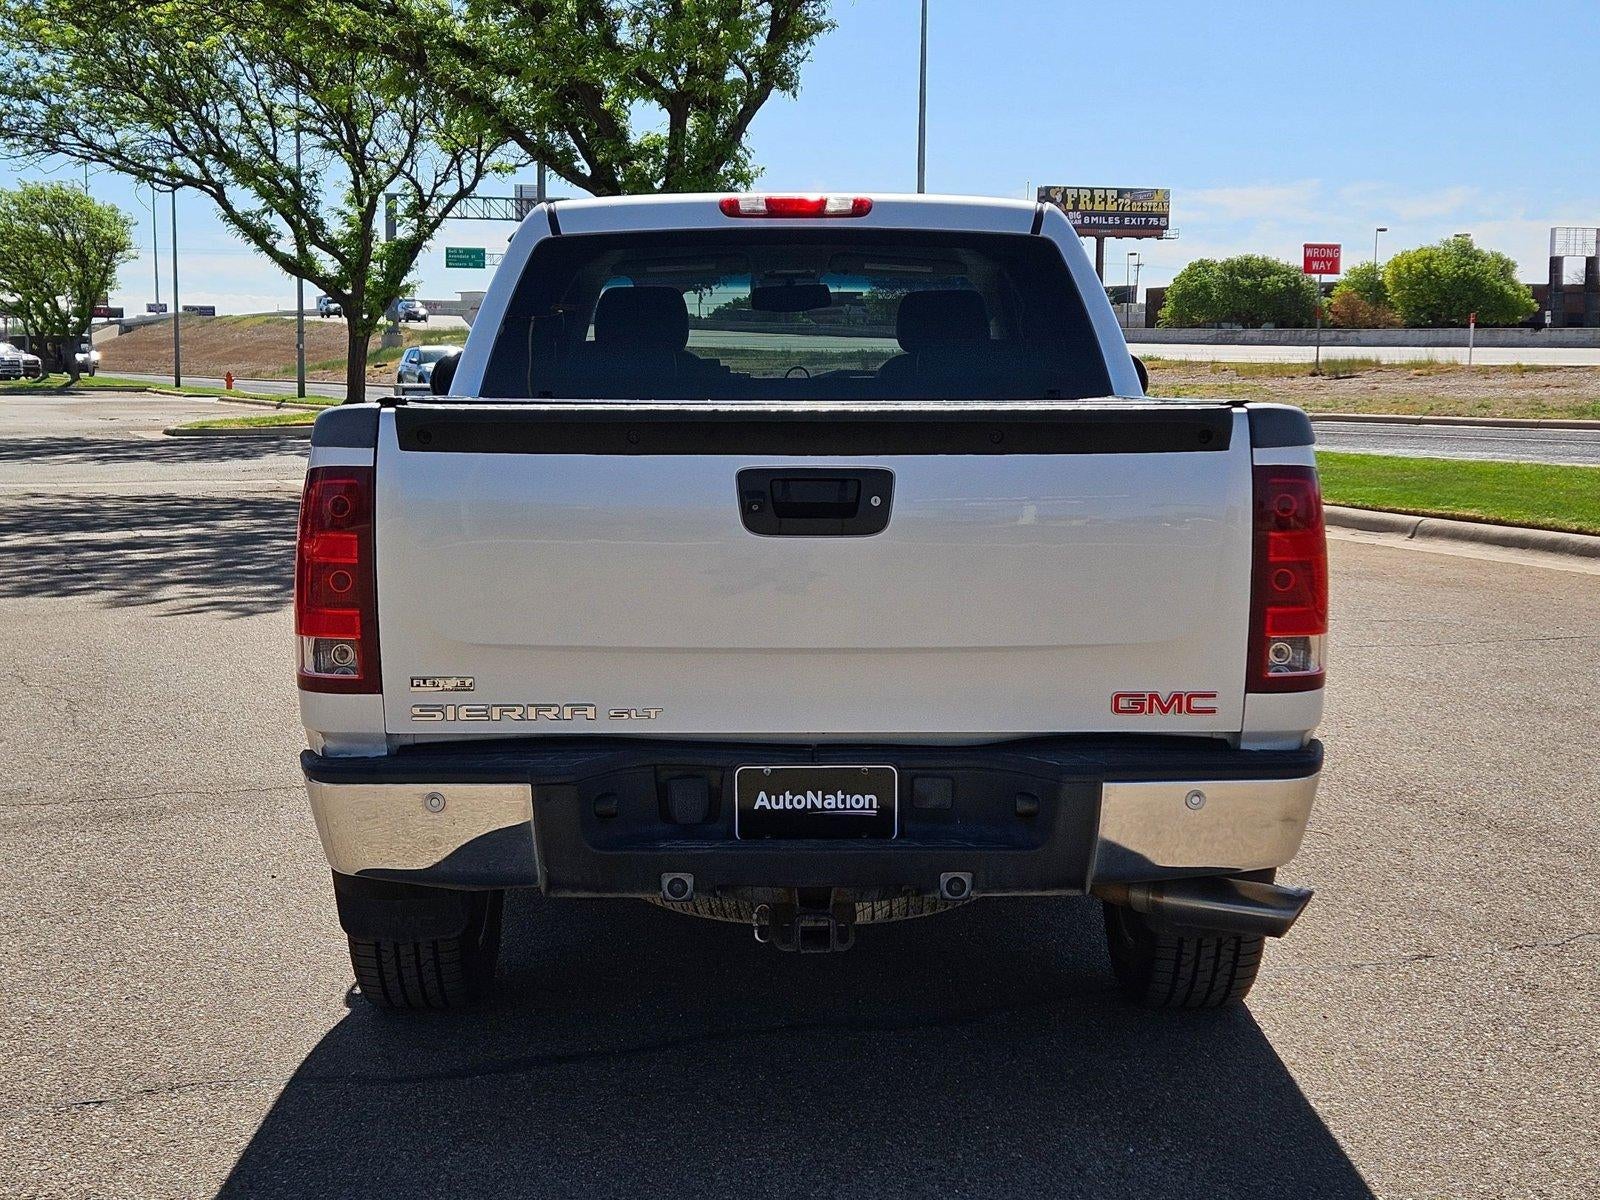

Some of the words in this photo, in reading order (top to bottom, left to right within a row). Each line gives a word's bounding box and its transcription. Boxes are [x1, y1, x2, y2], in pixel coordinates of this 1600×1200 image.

[1066, 188, 1118, 210] FREE
[1118, 198, 1130, 211] 72
[1131, 201, 1142, 212] OZ
[1142, 202, 1169, 212] STEAK
[1068, 211, 1082, 219] BIG
[1083, 216, 1090, 224] 8
[1090, 216, 1121, 225] MILES
[1124, 217, 1146, 225] EXIT
[1147, 217, 1159, 226] 75
[1305, 247, 1340, 258] WRONG
[1311, 260, 1333, 270] WAY
[1111, 691, 1219, 715] GMC
[411, 703, 597, 722] SIERRA
[608, 708, 664, 720] SLT
[753, 789, 879, 810] AutoNation
